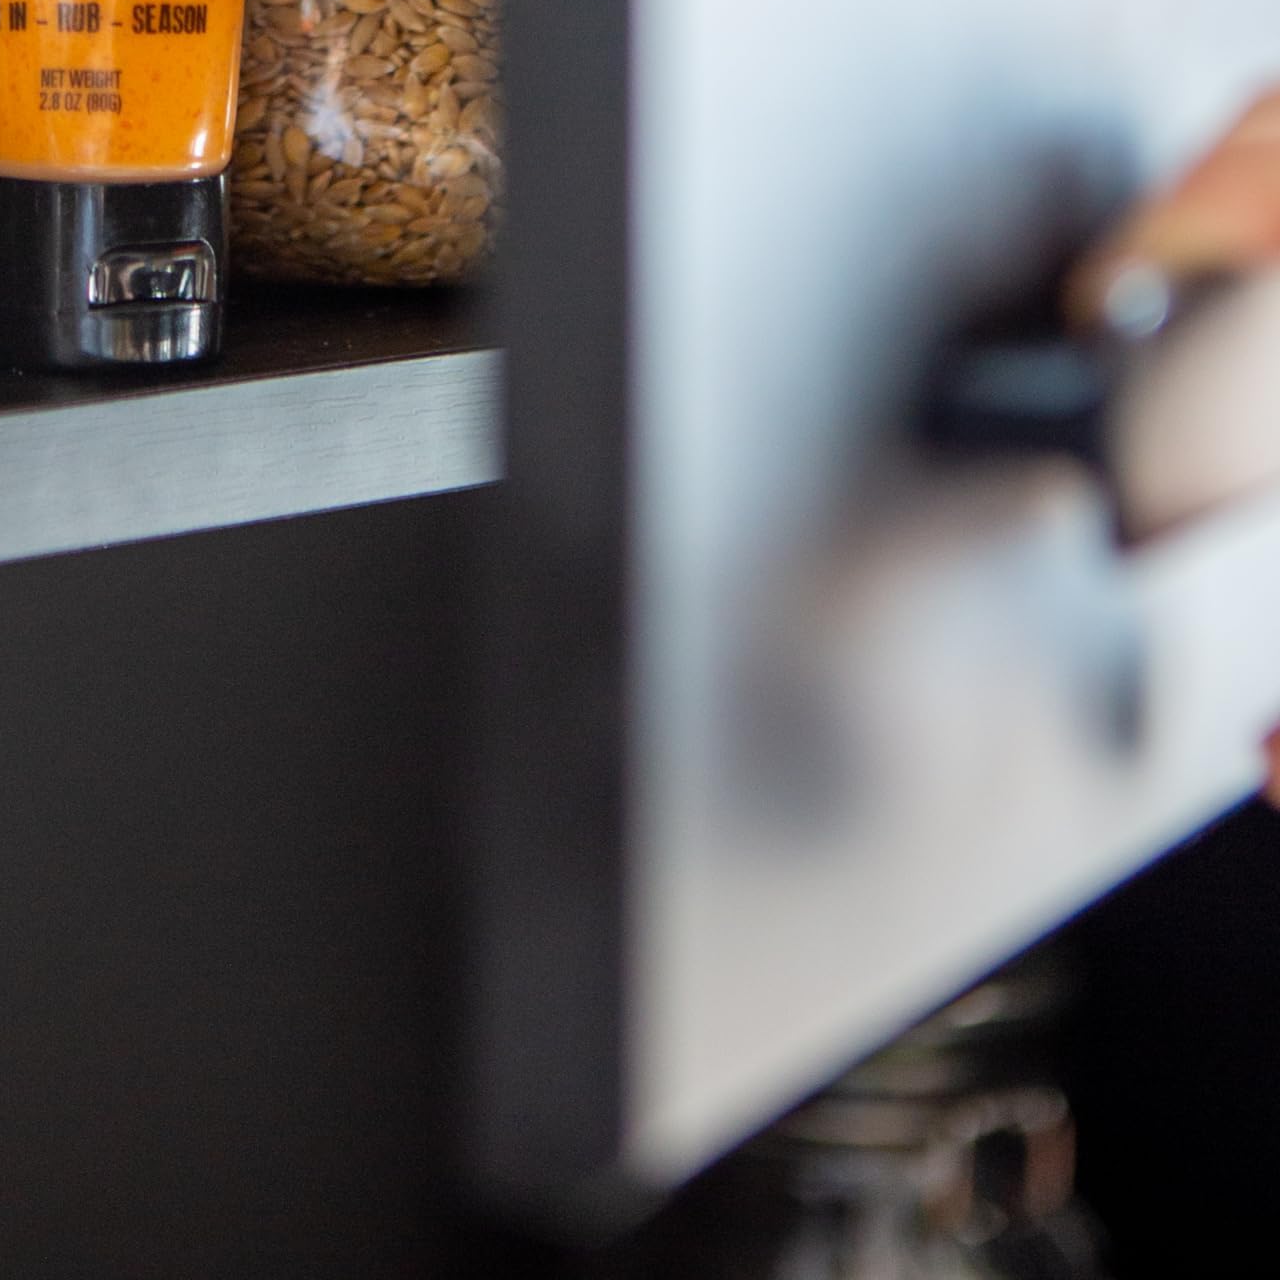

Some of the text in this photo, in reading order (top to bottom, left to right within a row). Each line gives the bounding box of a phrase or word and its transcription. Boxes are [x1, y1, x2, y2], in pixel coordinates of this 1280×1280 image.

[9, 1, 28, 31] IN
[57, 1, 101, 33] RUB
[132, 2, 208, 35] SEASON
[40, 68, 122, 88] NET WEIGHT
[39, 91, 60, 112] 2.8
[64, 91, 82, 112] OZ
